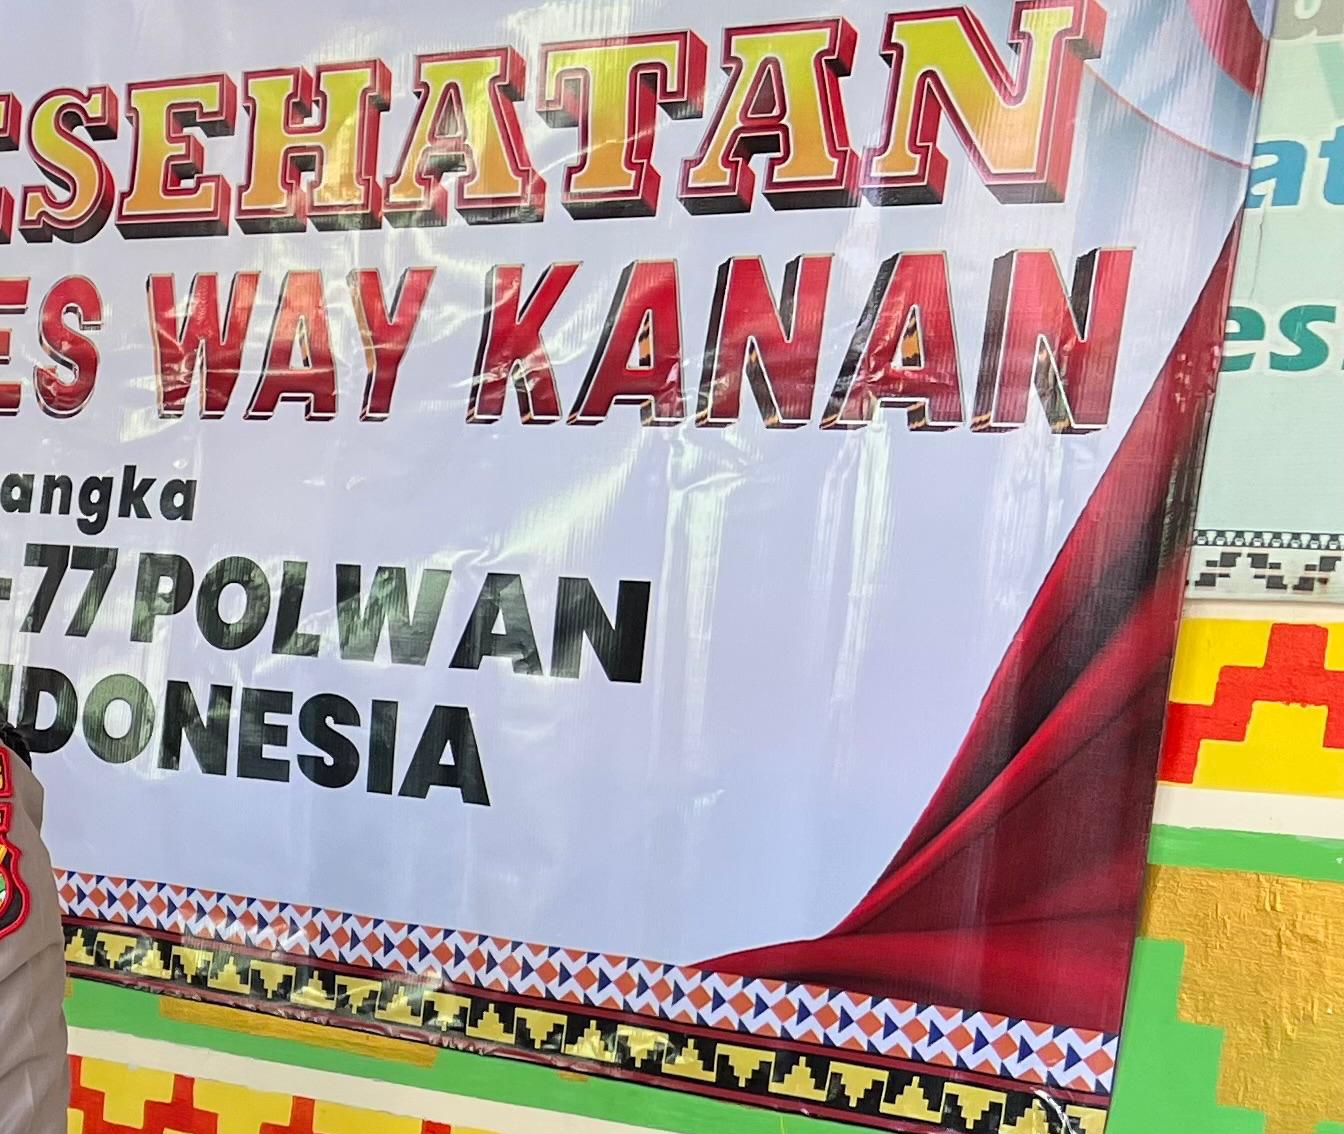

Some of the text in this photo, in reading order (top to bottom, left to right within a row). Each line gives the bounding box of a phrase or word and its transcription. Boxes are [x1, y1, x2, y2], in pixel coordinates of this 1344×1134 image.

[146, 266, 437, 424] WAY
[466, 246, 1136, 435] KANAN
[130, 550, 651, 684] POLWAN
